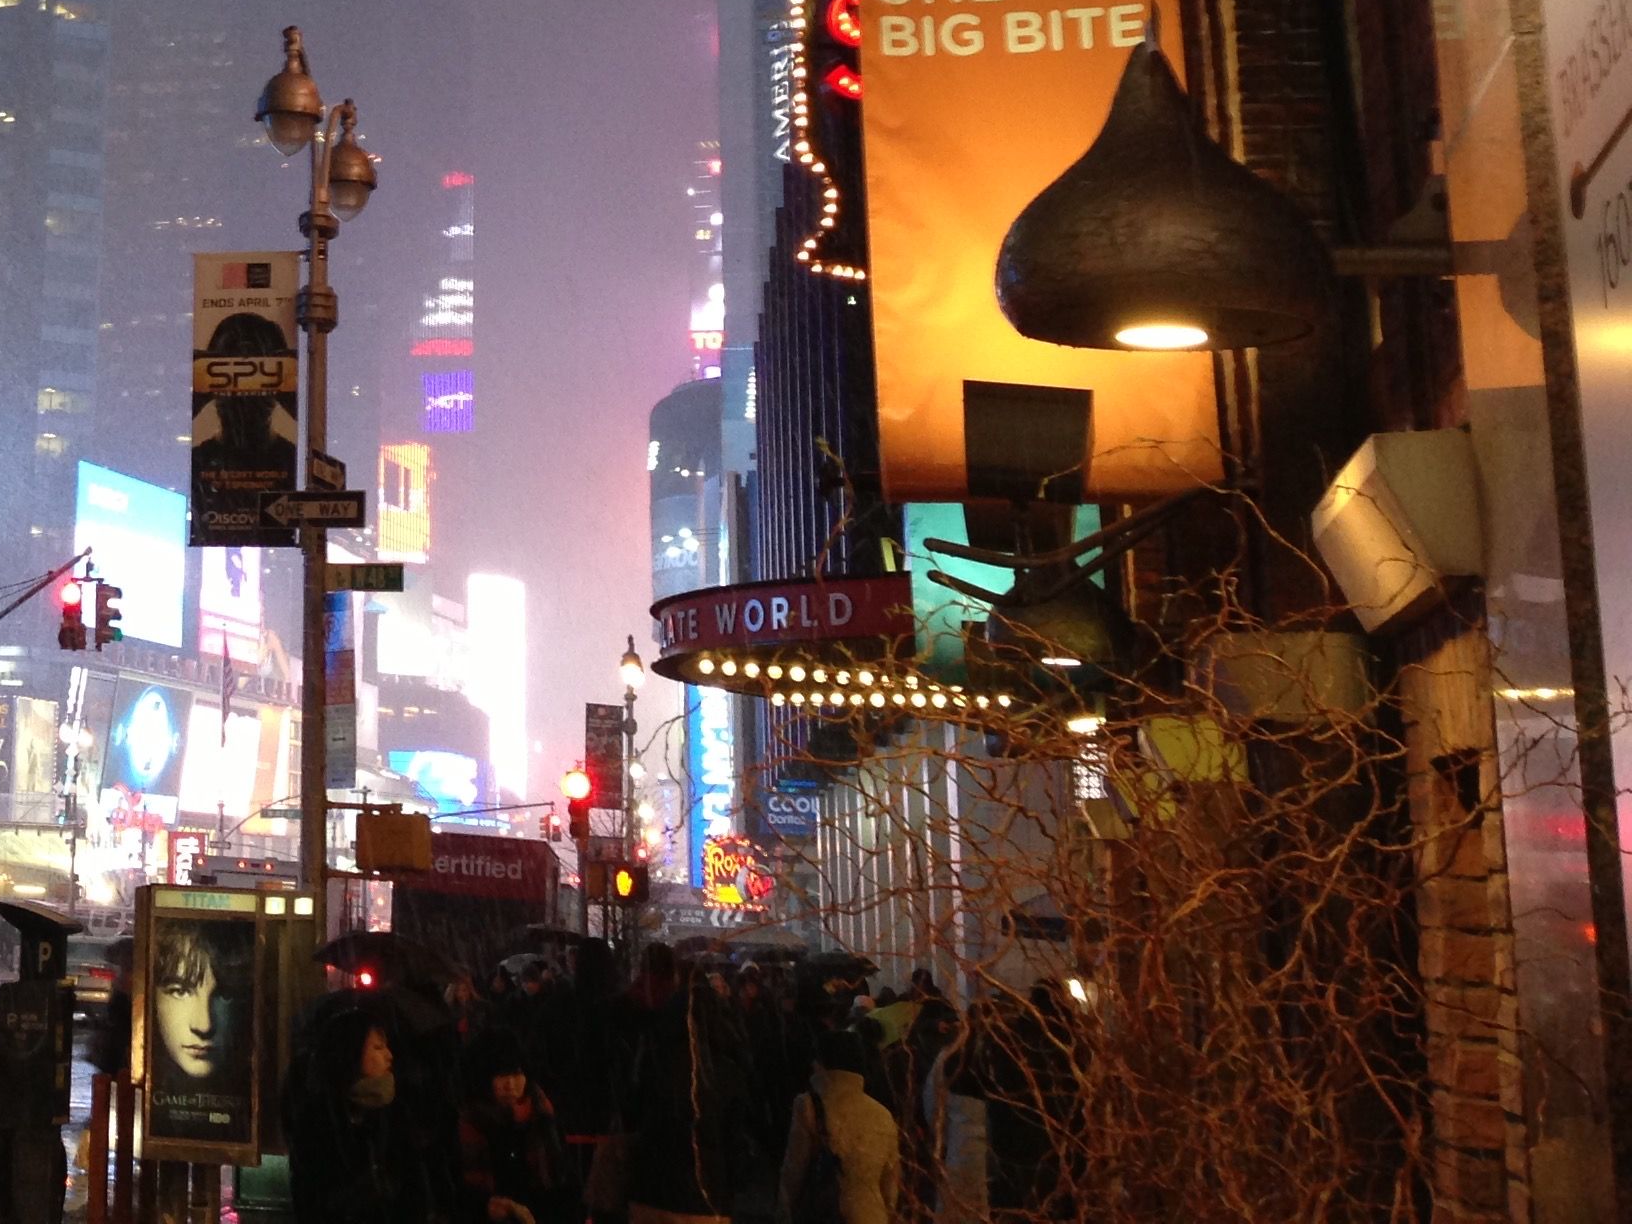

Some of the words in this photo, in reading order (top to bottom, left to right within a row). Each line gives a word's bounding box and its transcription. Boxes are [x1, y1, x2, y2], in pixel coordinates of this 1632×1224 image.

[879, 13, 985, 57] BIG
[1003, 3, 1146, 54] BITE
[206, 360, 284, 389] SPY
[208, 511, 256, 524] DISCOV
[319, 503, 351, 516] WAY
[715, 592, 853, 635] WORLD
[434, 853, 523, 879] ertified
[181, 892, 231, 907] TITAN
